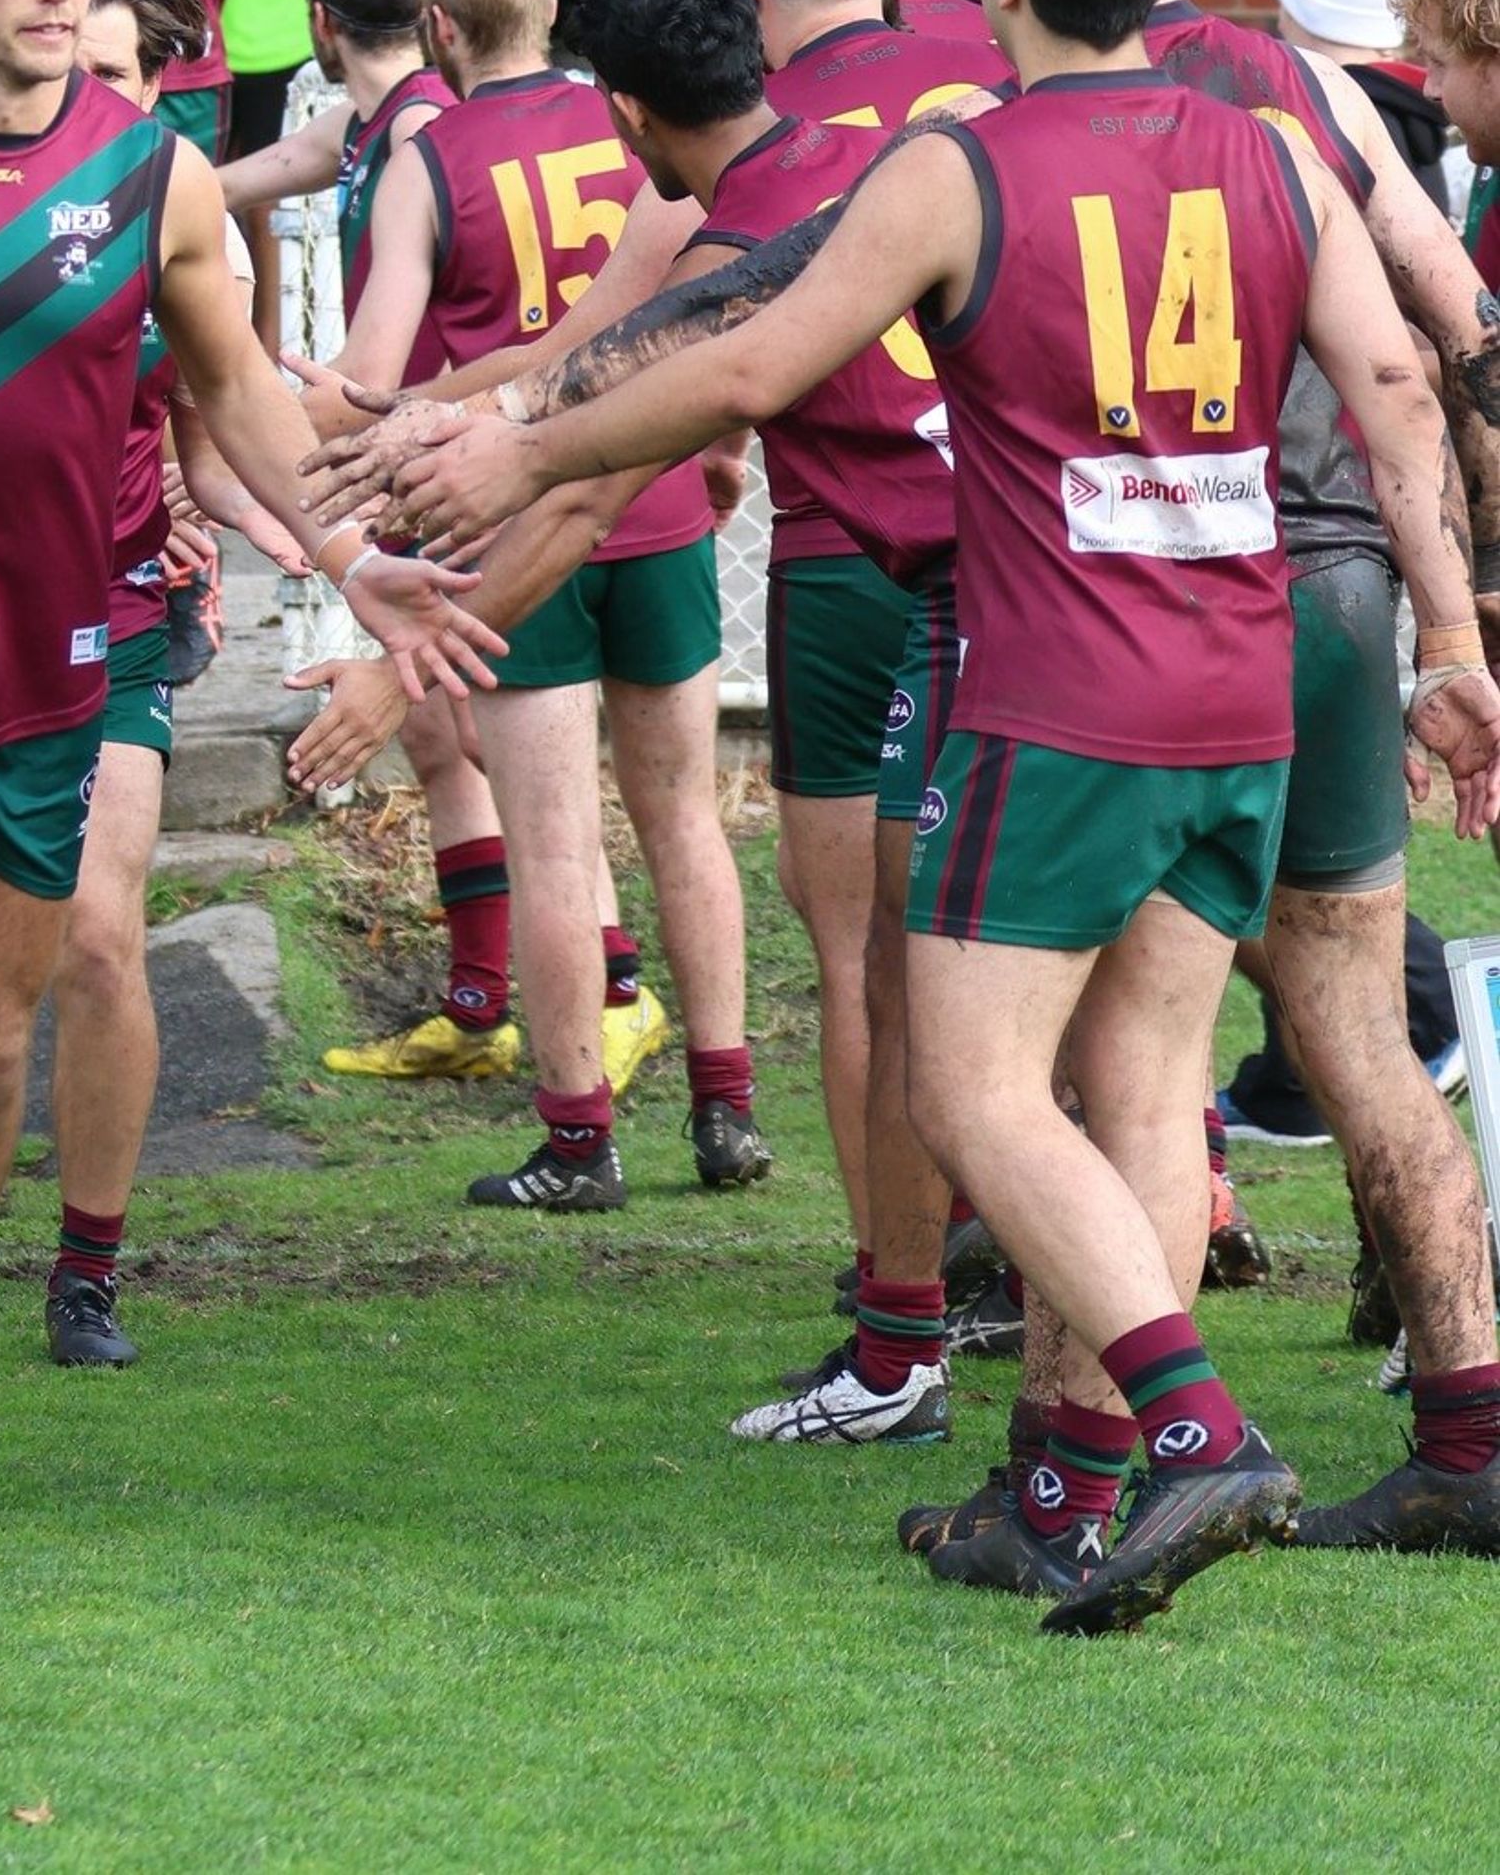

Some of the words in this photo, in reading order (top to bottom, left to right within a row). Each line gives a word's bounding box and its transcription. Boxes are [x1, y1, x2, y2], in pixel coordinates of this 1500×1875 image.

[51, 208, 111, 231] NED
[489, 139, 627, 333] 15
[1072, 188, 1241, 437] 14
